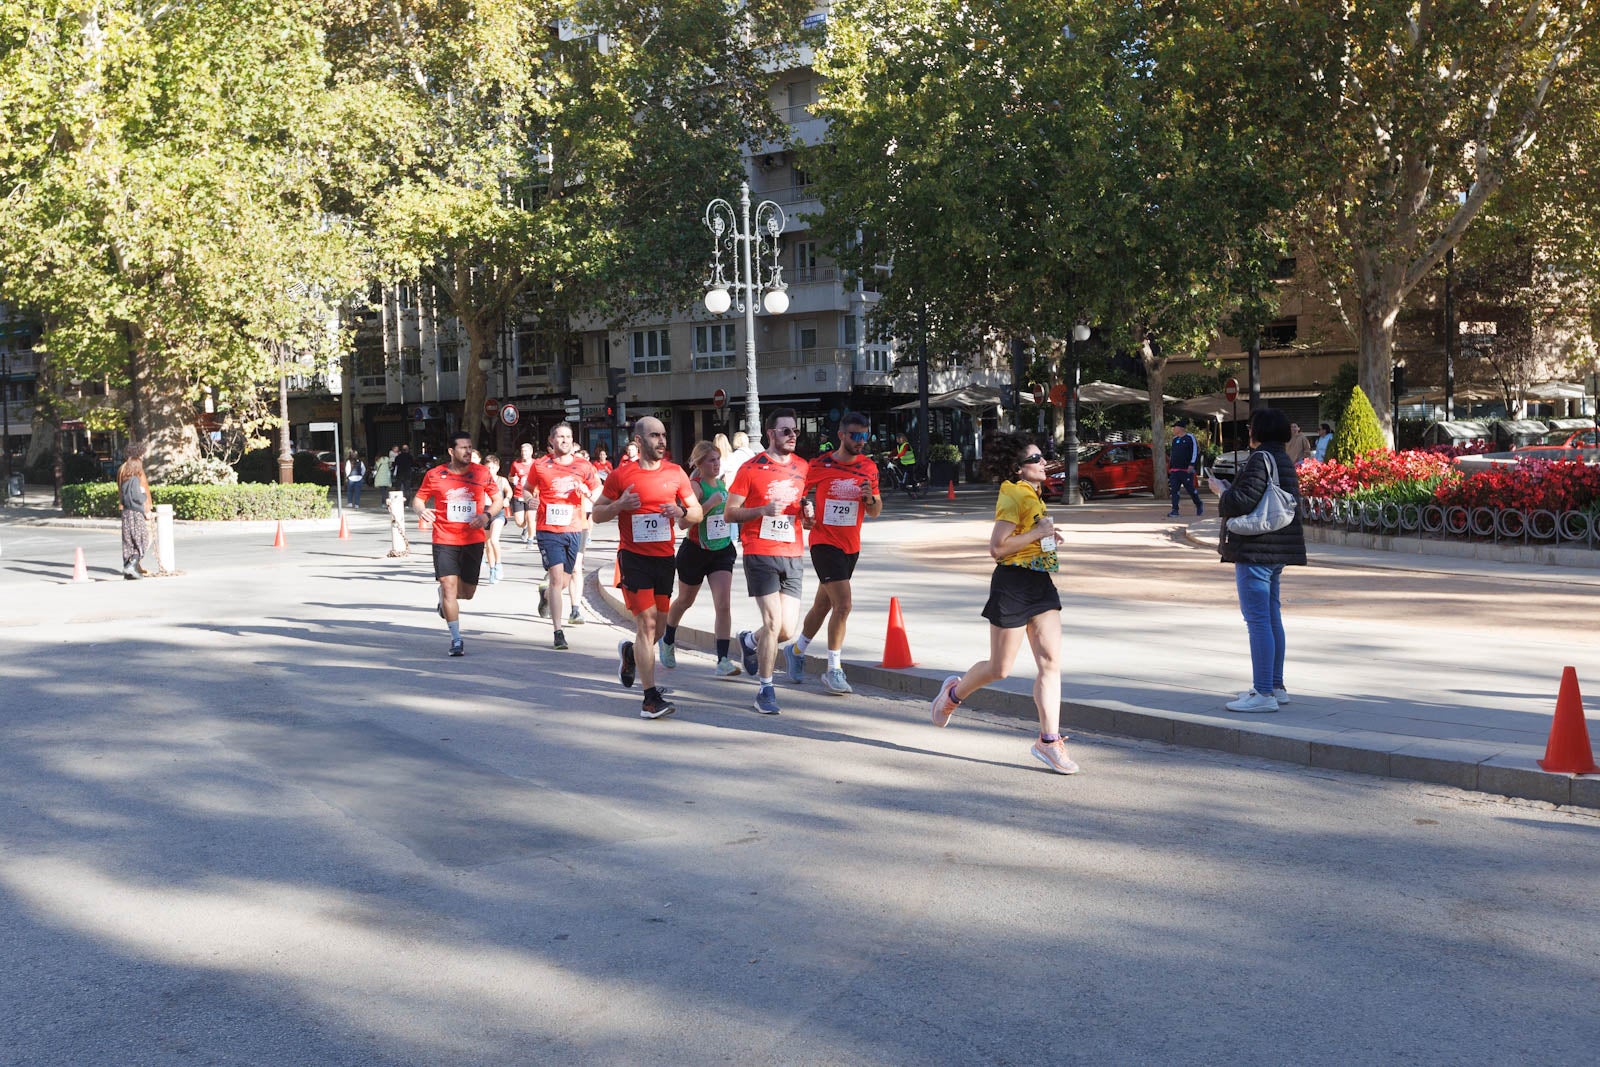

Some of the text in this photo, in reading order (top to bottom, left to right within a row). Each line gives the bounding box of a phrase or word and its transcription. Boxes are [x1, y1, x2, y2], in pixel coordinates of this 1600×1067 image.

[805, 14, 825, 23] VENDE
[453, 505, 472, 513] 1189
[550, 508, 569, 516] 1035
[832, 505, 850, 514] 729
[644, 519, 658, 529] 70
[713, 519, 726, 528] 73
[771, 520, 789, 530] 136
